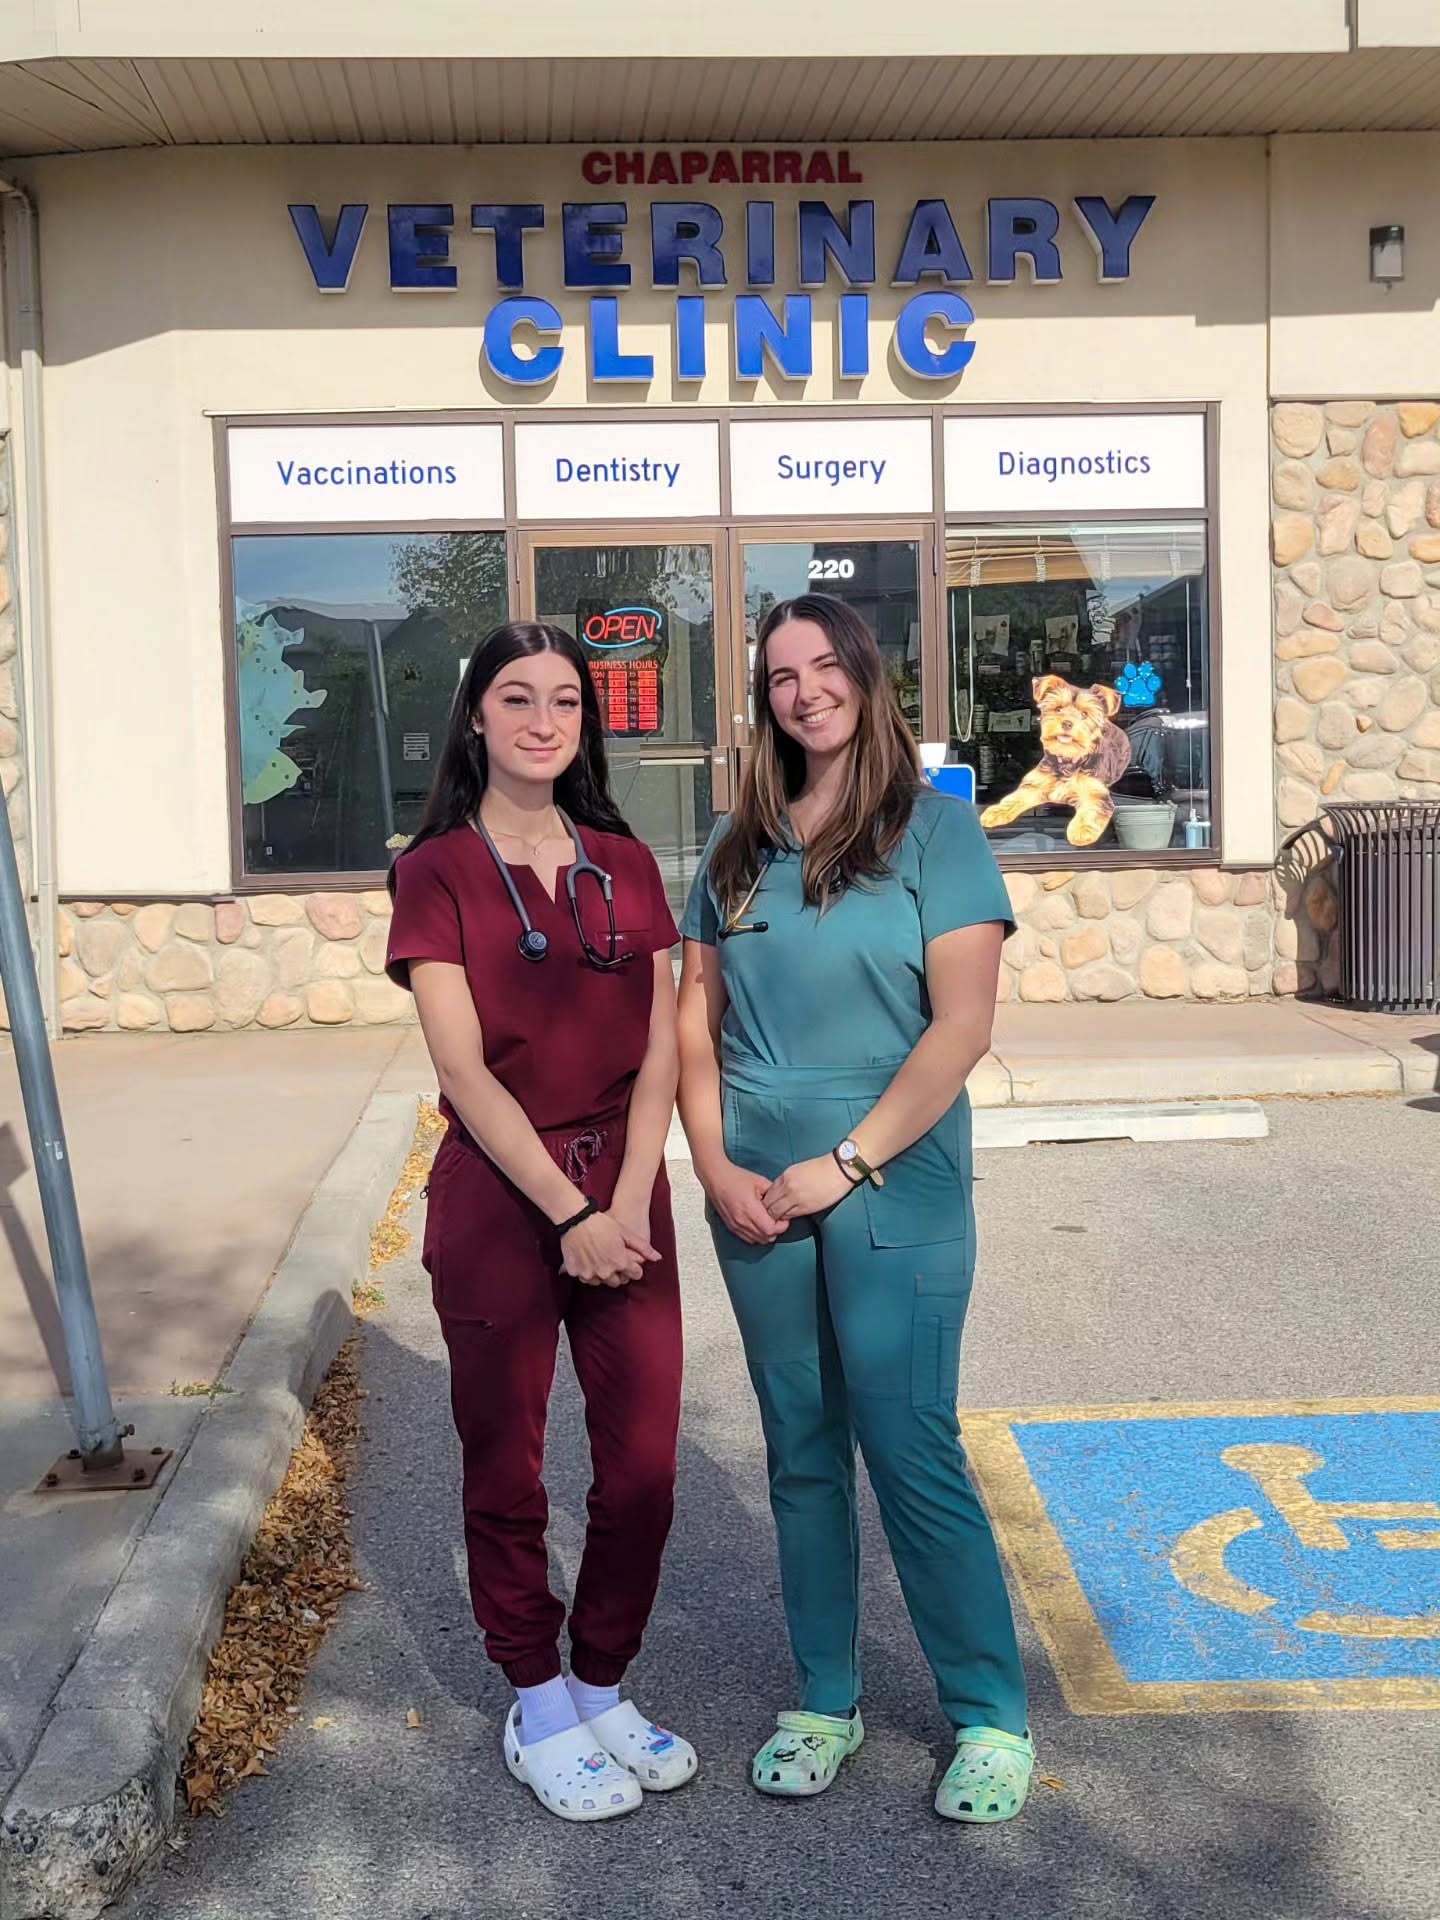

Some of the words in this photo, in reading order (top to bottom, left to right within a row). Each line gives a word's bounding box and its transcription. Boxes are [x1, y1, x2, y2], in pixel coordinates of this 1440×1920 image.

[582, 150, 863, 185] CHAPARRAL
[286, 195, 1157, 294] VETERINARY
[483, 291, 977, 387] CLINIC
[276, 459, 457, 486] Vaccinations
[555, 457, 681, 487] Dentistry
[777, 454, 887, 486] Surgery
[998, 449, 1151, 483] Diagnostics
[807, 558, 855, 579] 220
[585, 615, 656, 640] OPEN
[629, 660, 658, 670] HOURS
